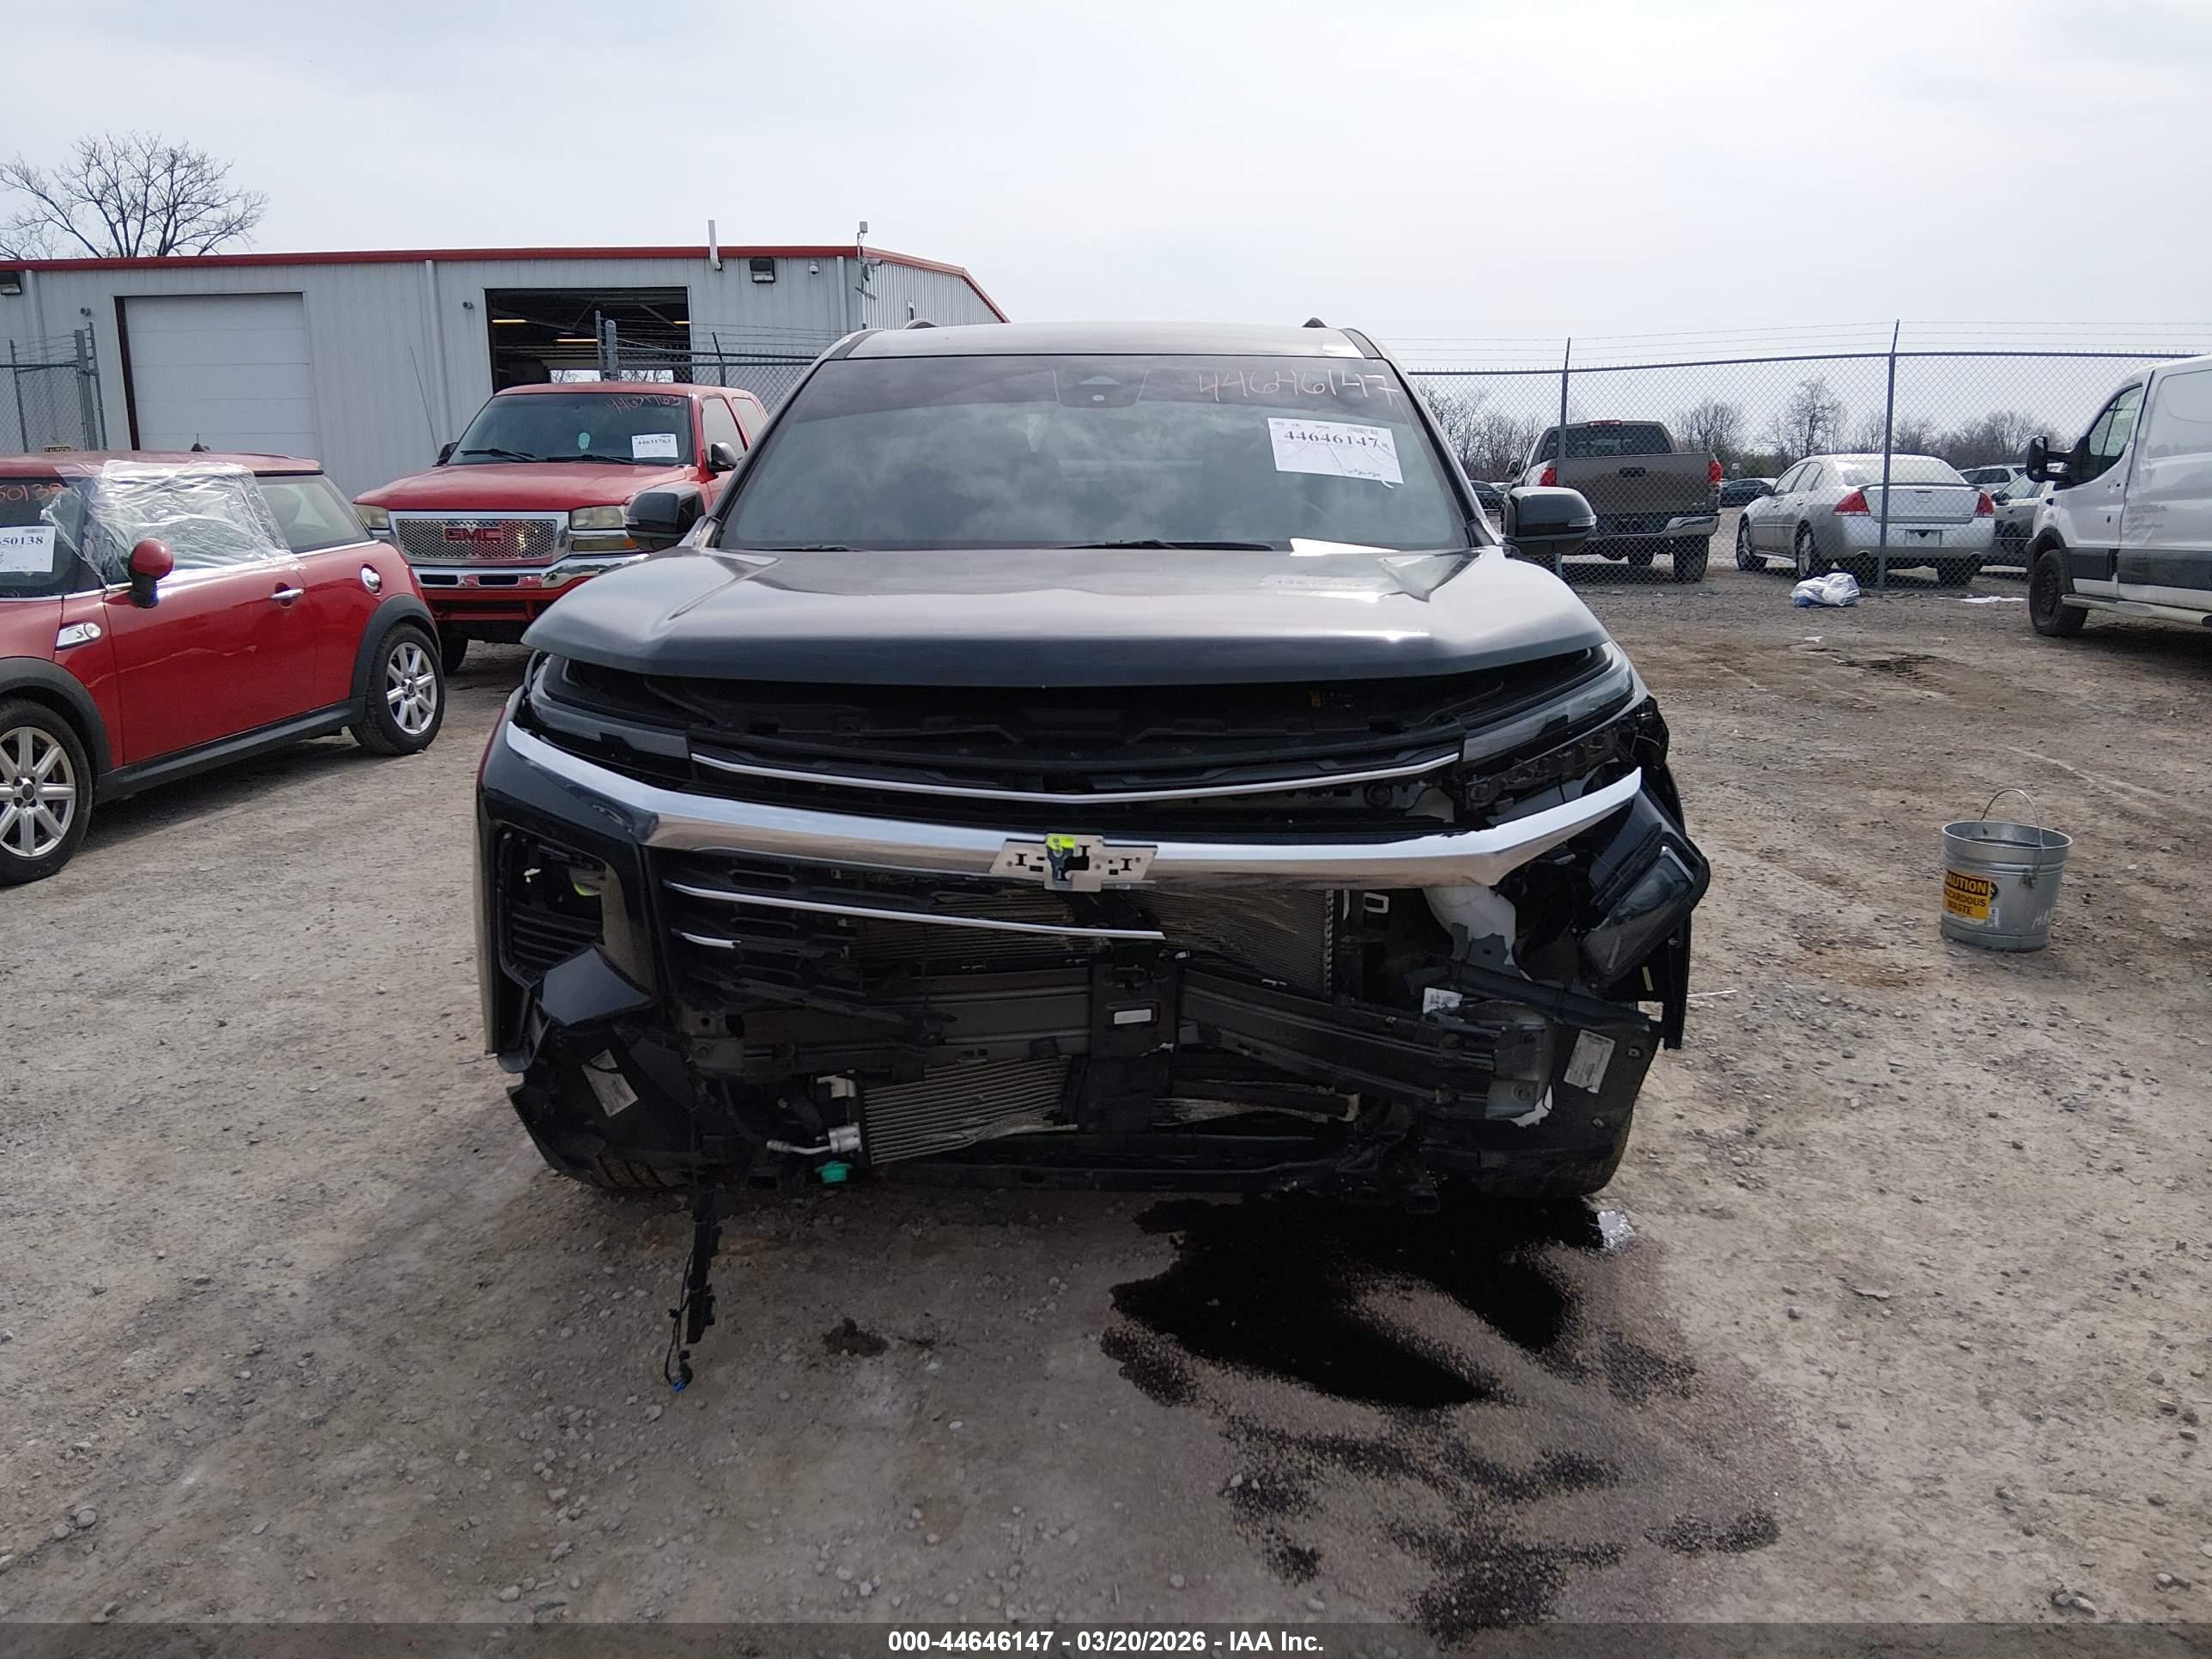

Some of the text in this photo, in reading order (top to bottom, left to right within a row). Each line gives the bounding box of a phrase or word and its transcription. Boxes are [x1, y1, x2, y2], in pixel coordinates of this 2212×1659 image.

[1199, 369, 1400, 406] 44646147
[1284, 429, 1379, 449] 44646147
[0, 536, 44, 546] 50138
[445, 527, 502, 542] GMC
[1947, 872, 1987, 894] AUTION
